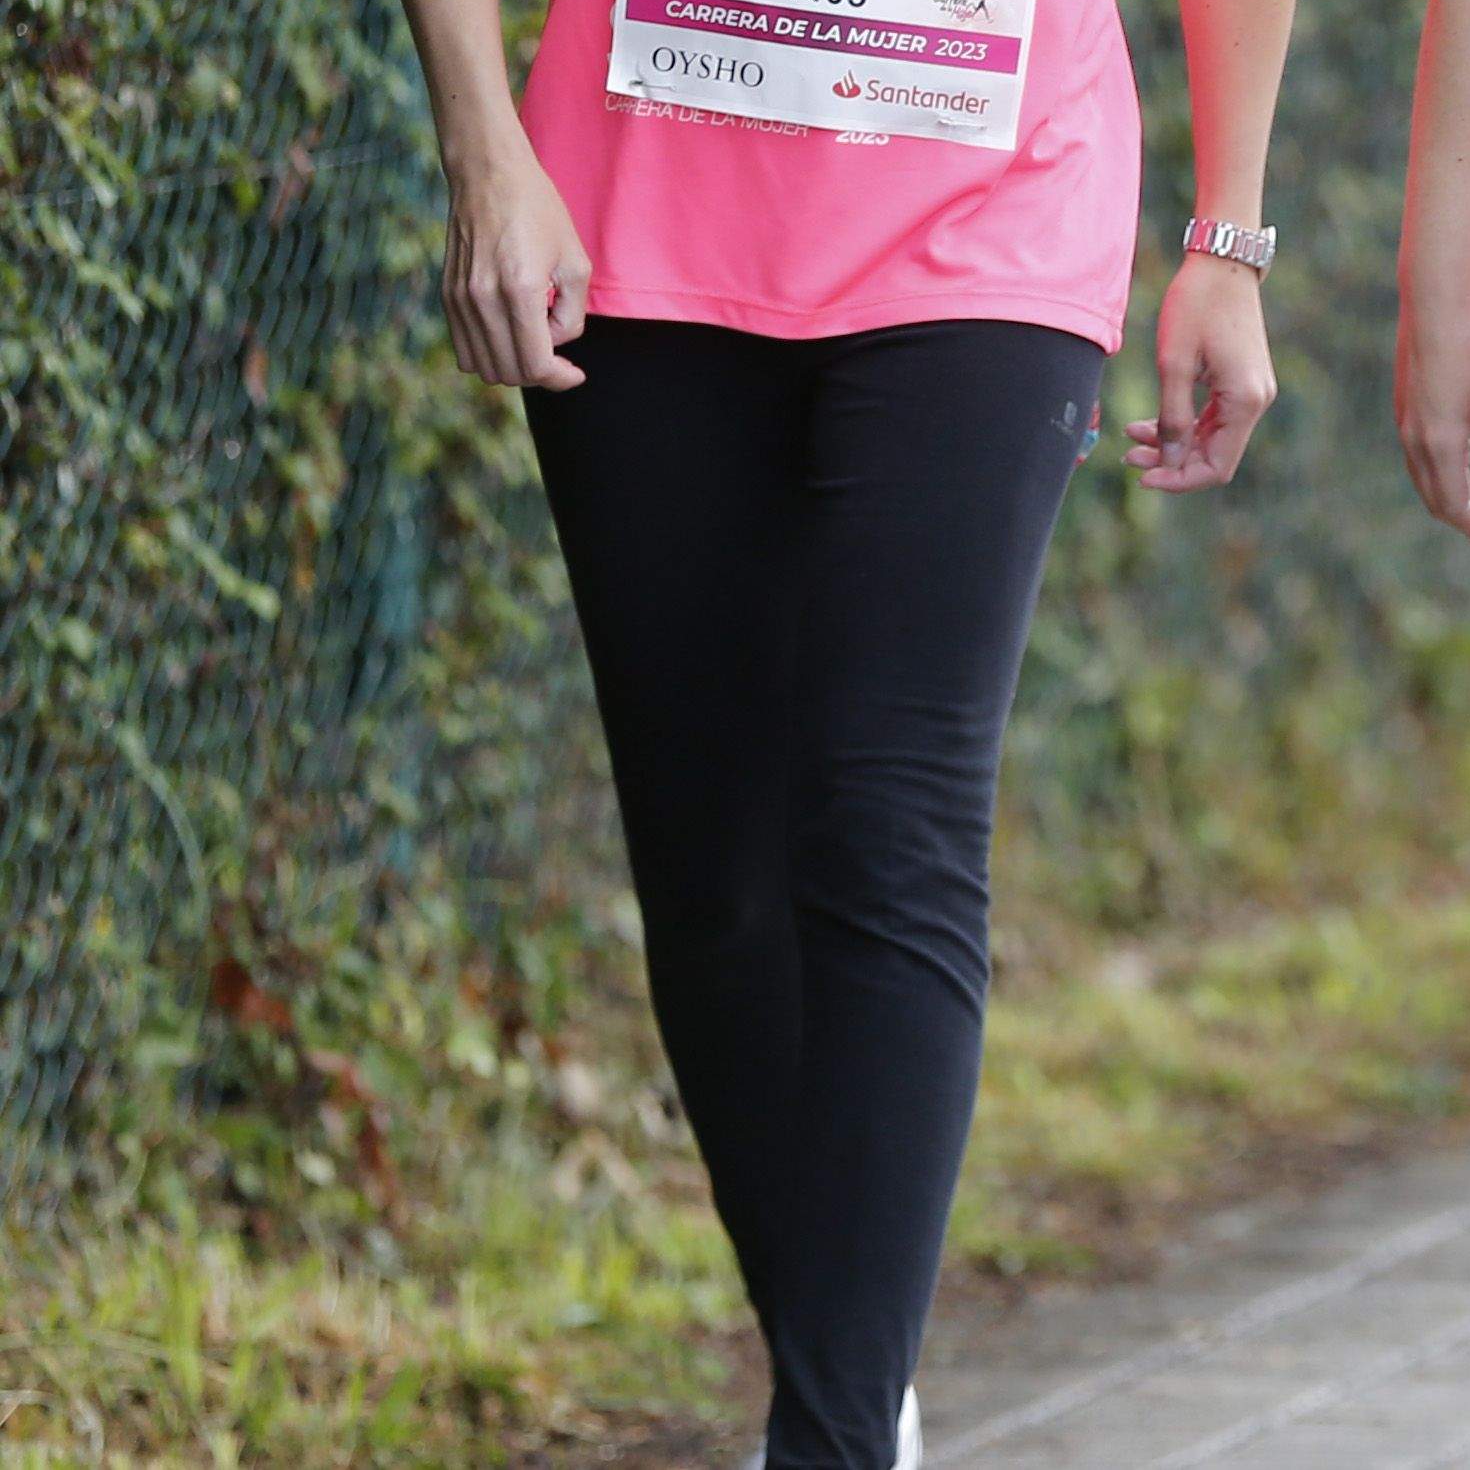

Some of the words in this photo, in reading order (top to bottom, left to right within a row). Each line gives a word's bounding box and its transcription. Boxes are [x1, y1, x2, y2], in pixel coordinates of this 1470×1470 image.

[665, 0, 768, 32] CARRERA
[774, 17, 807, 38] DE
[811, 22, 841, 44] LA
[847, 28, 928, 54] MUJER
[935, 38, 988, 61] 2023
[652, 46, 766, 88] OYSHO
[865, 79, 990, 115] Santander
